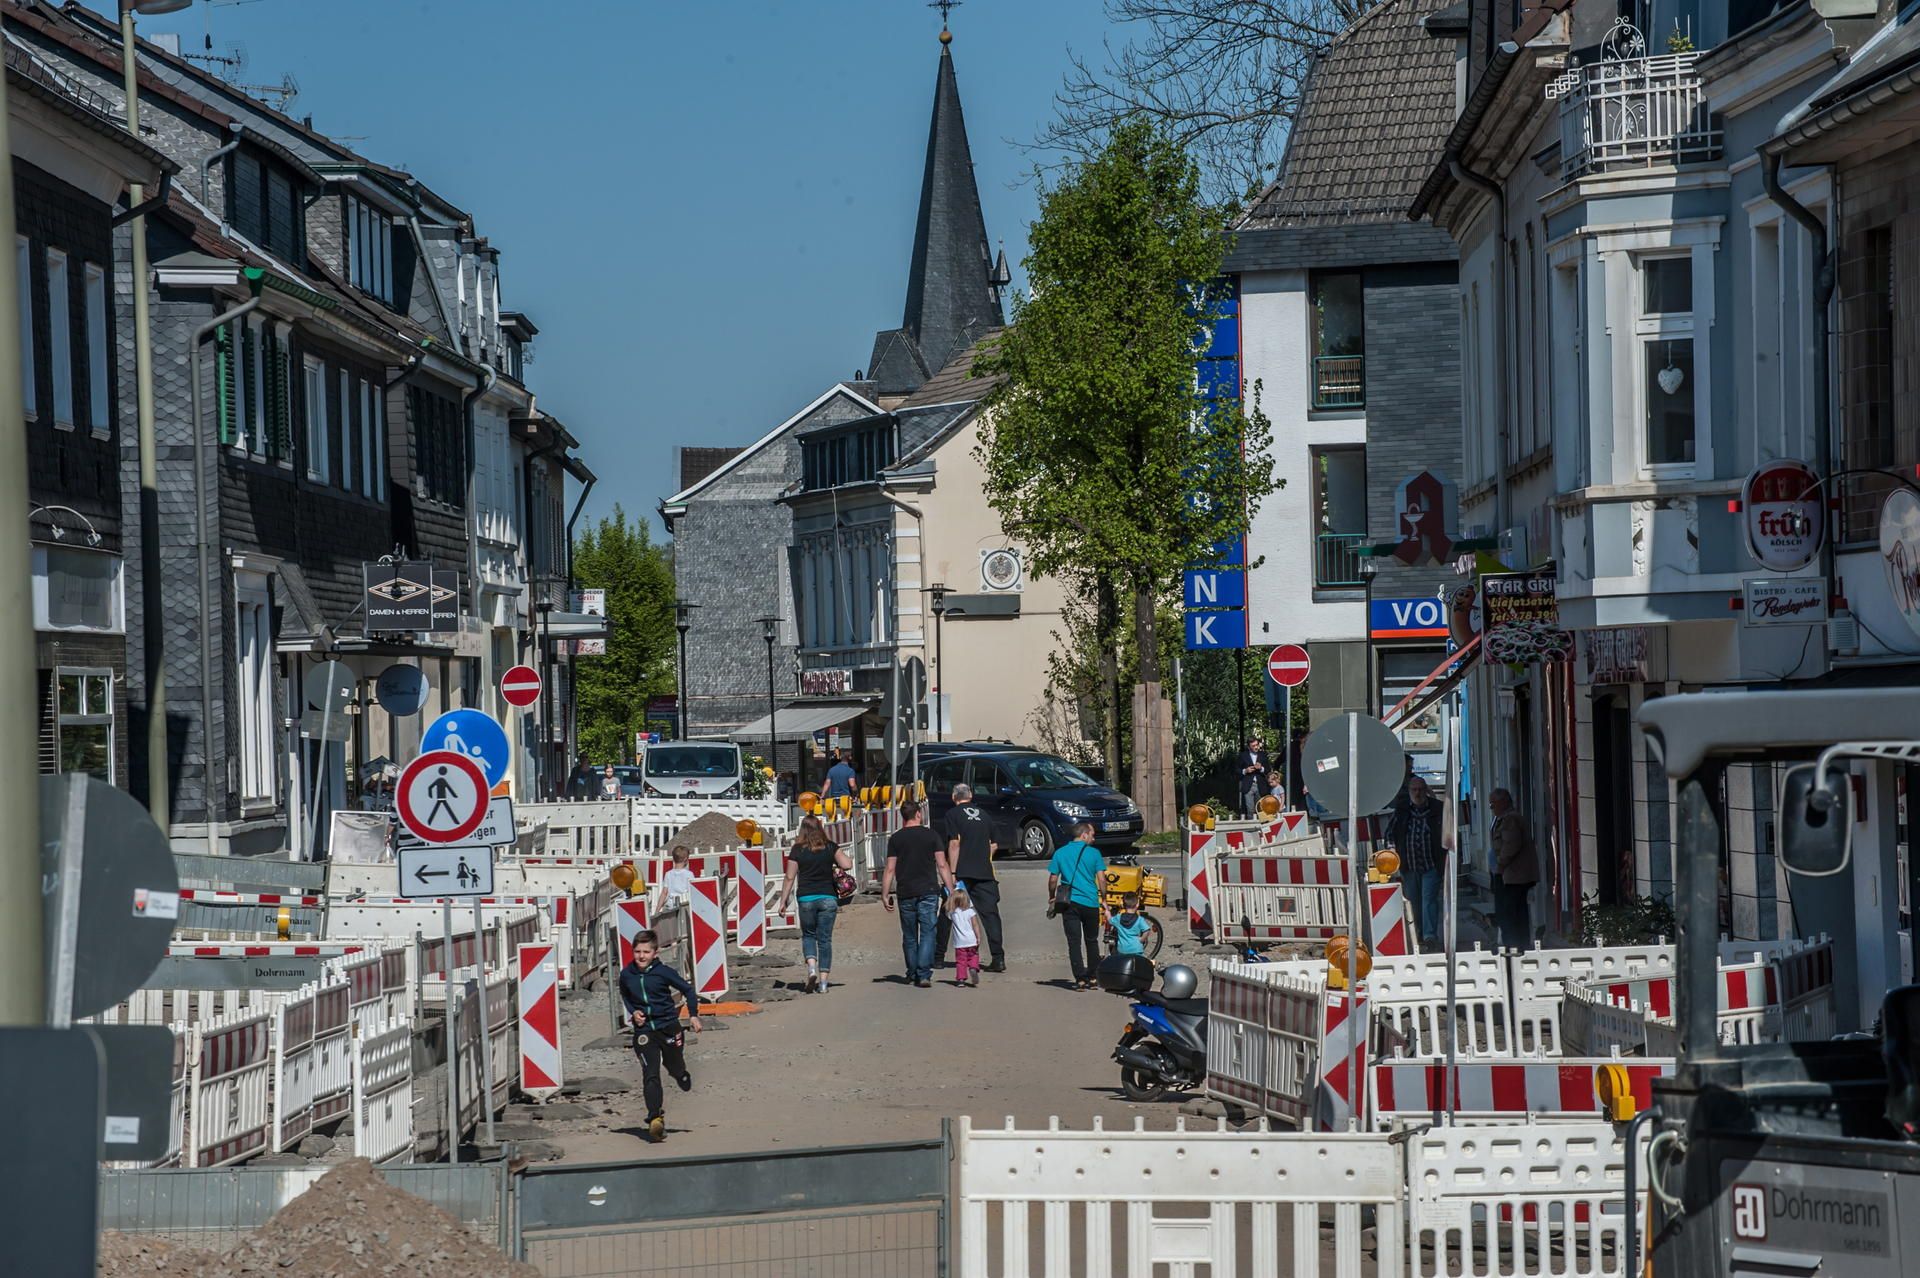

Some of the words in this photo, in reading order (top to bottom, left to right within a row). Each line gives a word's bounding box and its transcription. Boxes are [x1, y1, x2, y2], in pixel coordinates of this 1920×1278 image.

[1770, 538, 1802, 546] KÖLSCH
[1486, 579, 1523, 593] STAR
[265, 915, 311, 926] Domann
[255, 968, 305, 978] Dohrmann
[1771, 1187, 1880, 1228] Dohrmann
